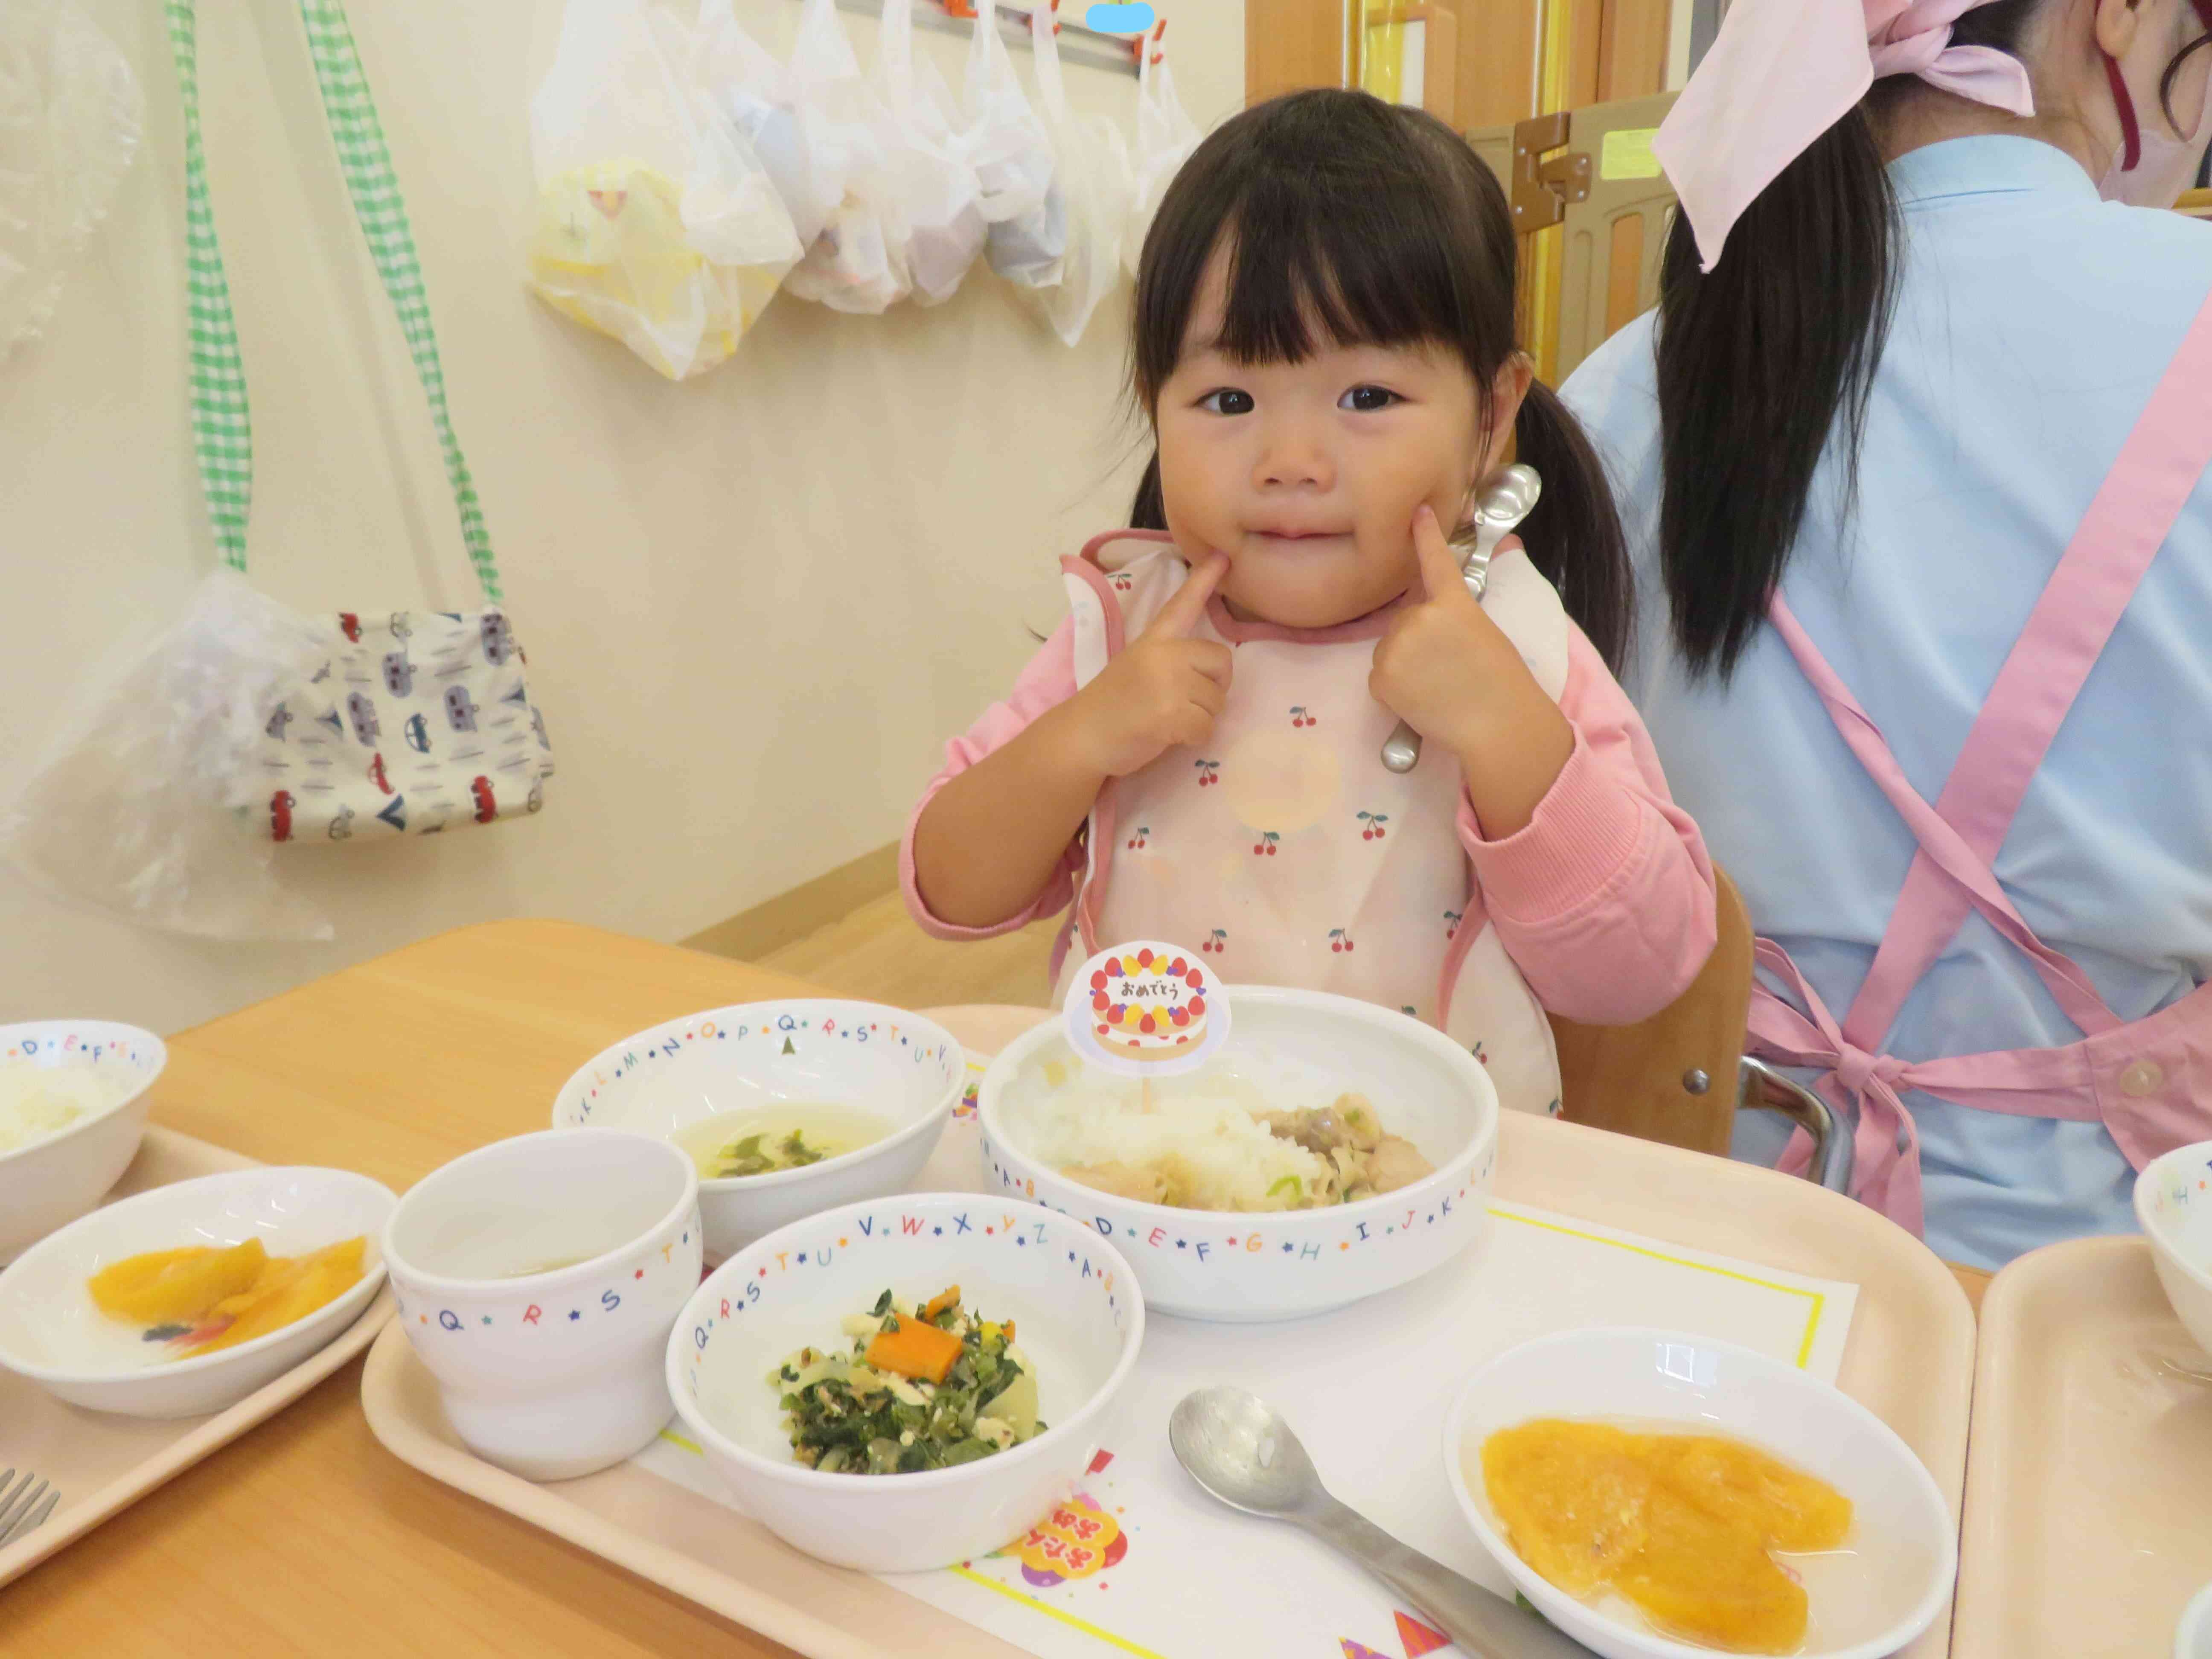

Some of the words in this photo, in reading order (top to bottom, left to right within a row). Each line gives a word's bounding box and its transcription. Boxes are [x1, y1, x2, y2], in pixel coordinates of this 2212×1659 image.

[1121, 981, 1178, 1001] おめでとう
[778, 1015, 797, 1030] Q
[822, 1019, 835, 1036] R
[857, 1026, 867, 1042] S
[1095, 1216, 1112, 1235] D
[1149, 1228, 1167, 1248] E
[1196, 1243, 1209, 1262] F
[1246, 1233, 1262, 1252] G
[1300, 1242, 1321, 1260] H
[1356, 1222, 1370, 1241] I
[1402, 1210, 1415, 1229] J
[439, 1310, 464, 1330] Q
[523, 1304, 542, 1325] R
[601, 1290, 620, 1311] S
[662, 1243, 672, 1263] T
[721, 1298, 730, 1319] R
[747, 1281, 760, 1302] S
[775, 1252, 789, 1270] T
[817, 1247, 832, 1266] U
[859, 1216, 872, 1236] V
[902, 1215, 925, 1235] W
[953, 1213, 972, 1234] X
[1033, 1224, 1048, 1243] Z
[1082, 1258, 1091, 1278] A
